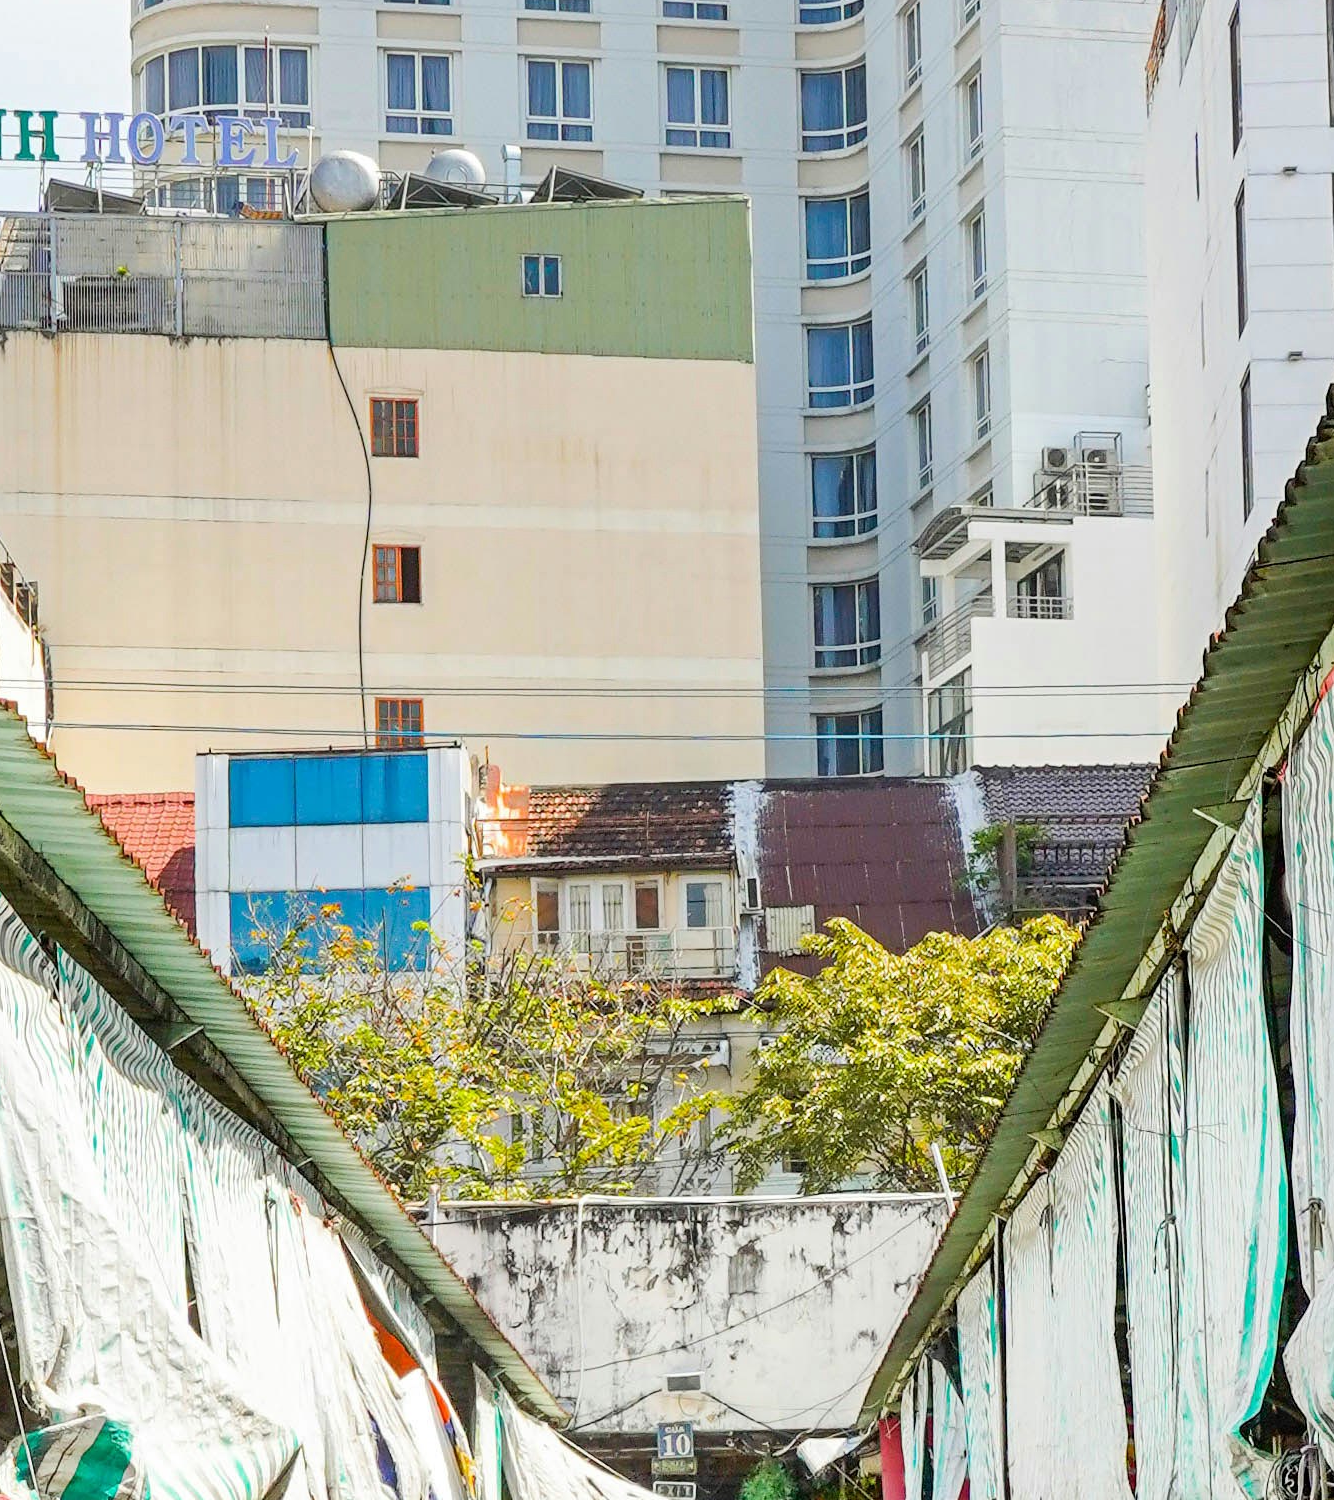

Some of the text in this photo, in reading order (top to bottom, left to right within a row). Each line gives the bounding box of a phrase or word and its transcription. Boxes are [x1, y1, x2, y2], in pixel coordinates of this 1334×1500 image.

[79, 111, 300, 169] HOTEL
[662, 1434, 691, 1456] 10
[657, 1484, 692, 1498] EXIT
